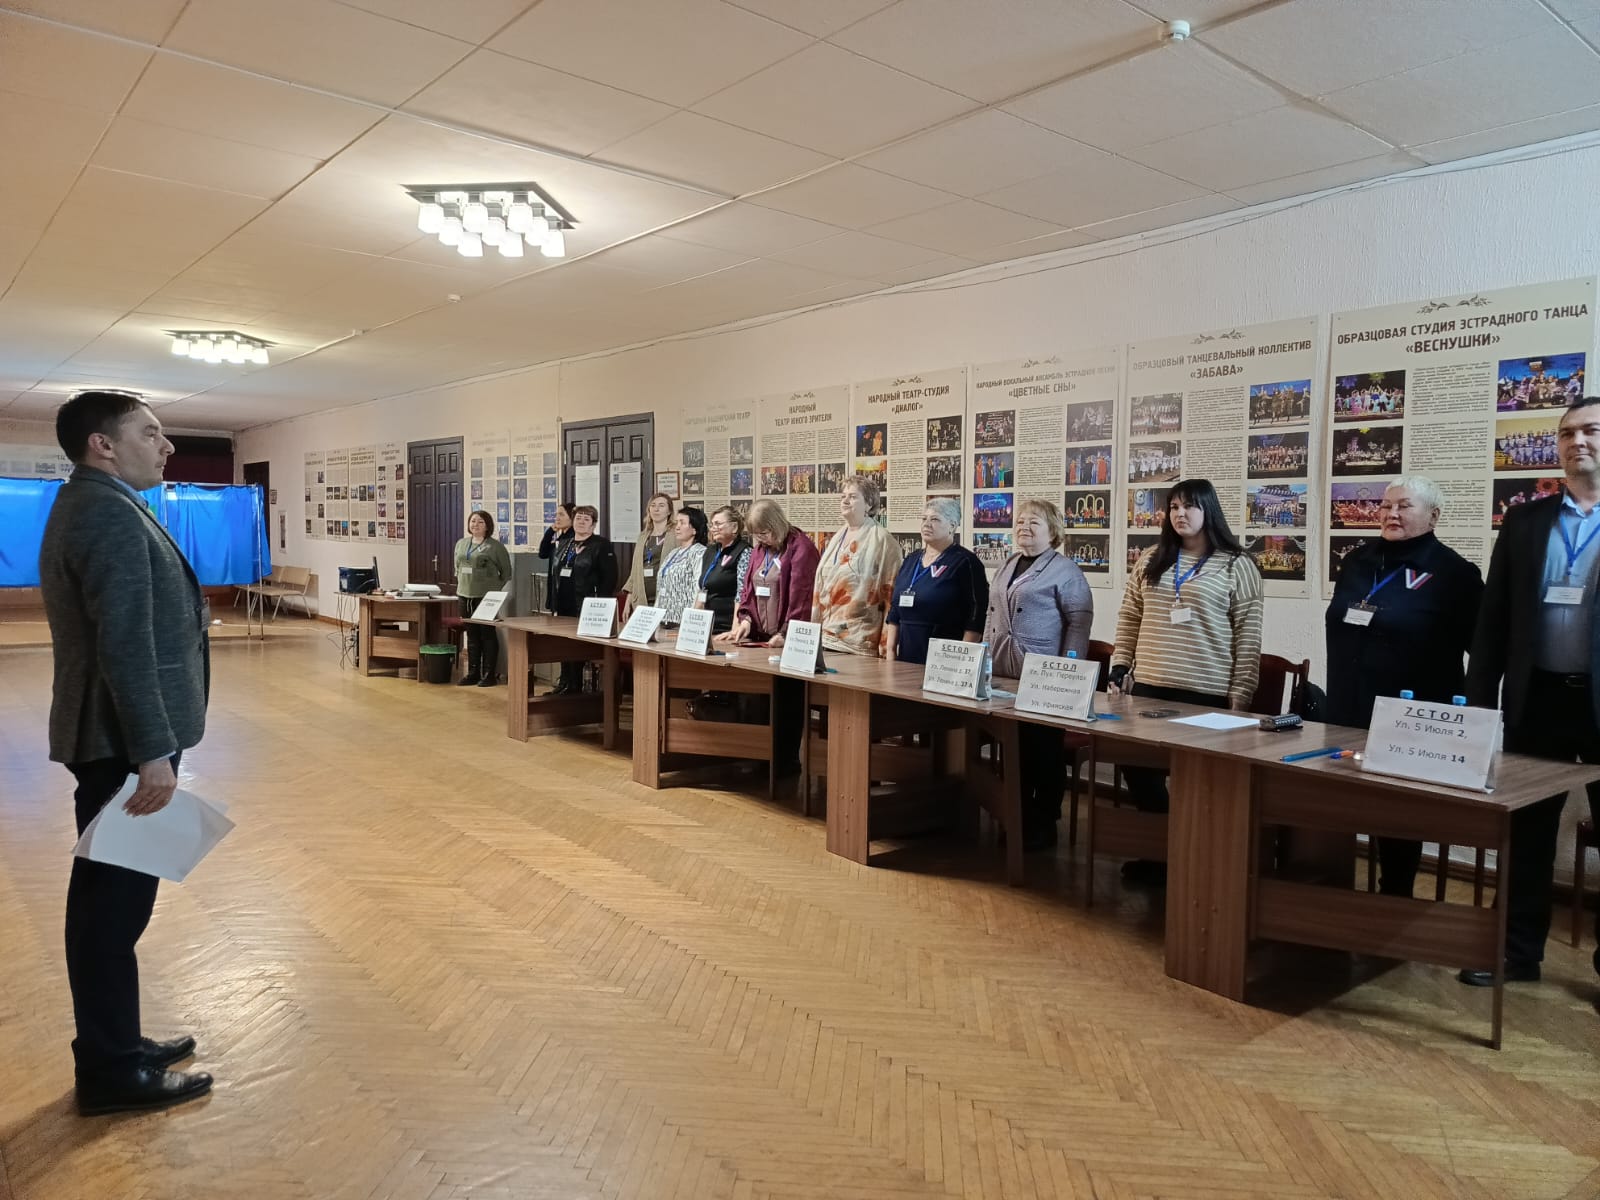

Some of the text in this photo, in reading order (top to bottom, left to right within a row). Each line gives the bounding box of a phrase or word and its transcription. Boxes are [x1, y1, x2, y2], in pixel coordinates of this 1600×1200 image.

[1338, 303, 1588, 345] ОБРАЗЦОВАЯ СТУДИЯ ЭСТРАДНОГО ТАНЦА
[1405, 333, 1501, 354] «ВЕСНУШКИ»
[1132, 339, 1312, 370] ОБРАЗЦОВЫЙ ТАНЦЕВАЛЬНЫЙ КОЛЛЕКТИВ
[868, 390, 901, 404] НАРОДНЫЙ
[1395, 719, 1410, 730] Ул.
[1414, 722, 1422, 732] 5
[1425, 724, 1454, 736] Июля
[1388, 743, 1466, 764] Ул. 5 Июля 14
